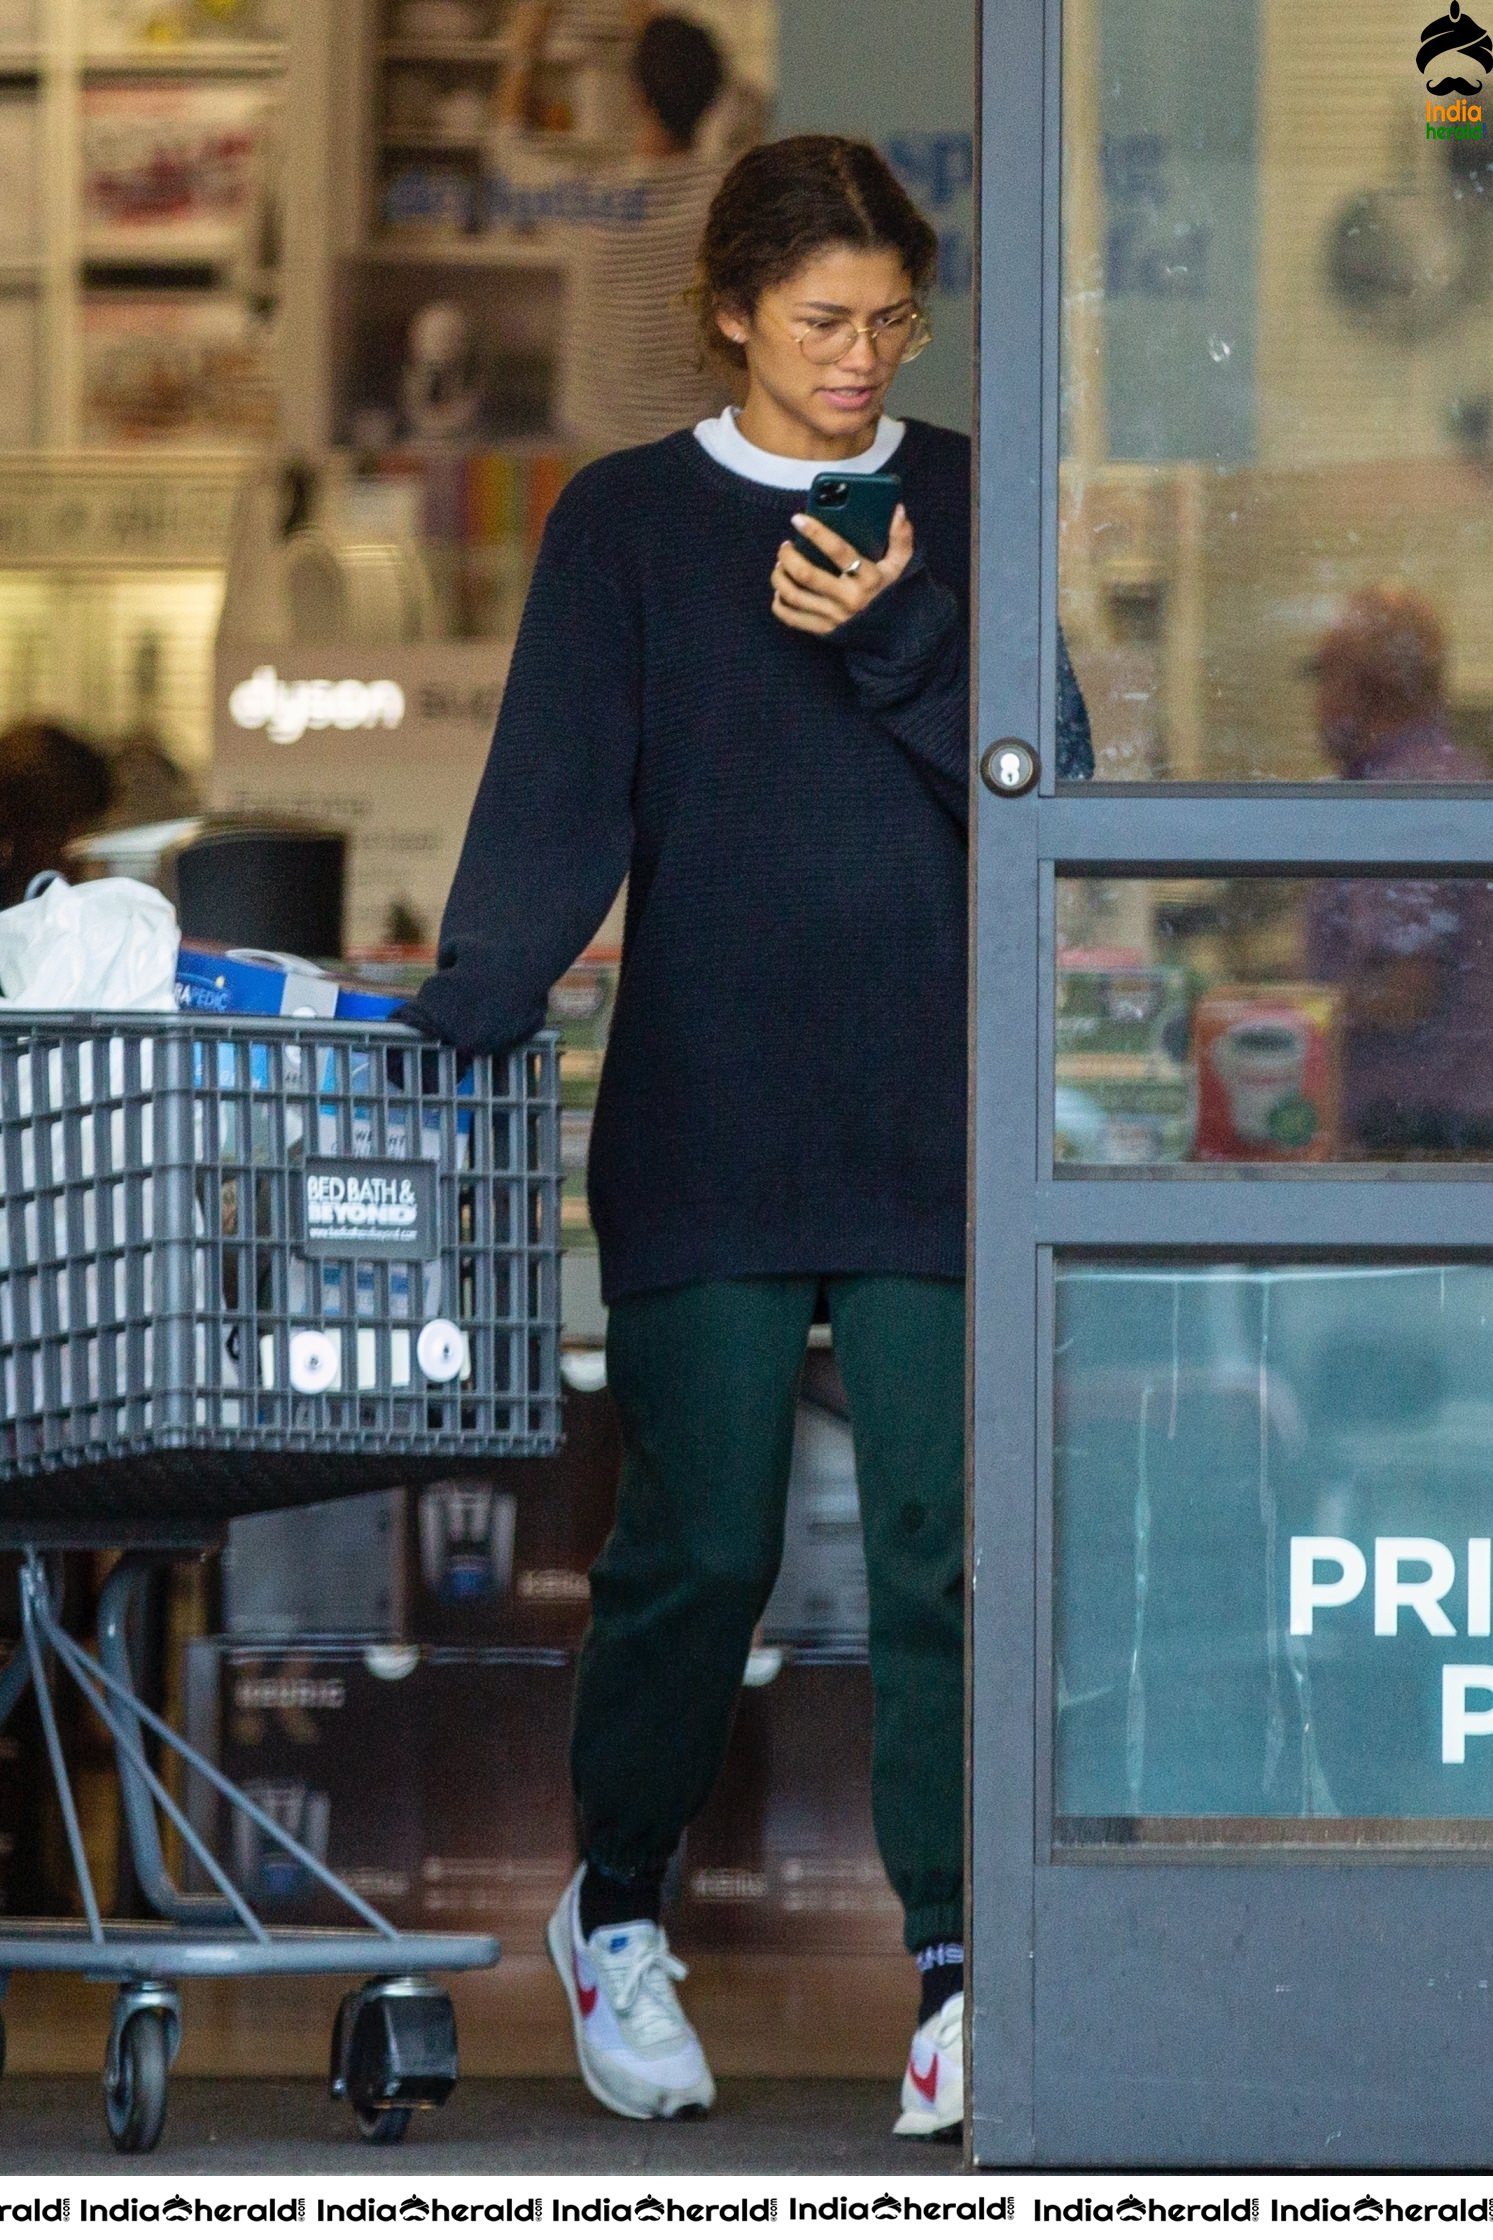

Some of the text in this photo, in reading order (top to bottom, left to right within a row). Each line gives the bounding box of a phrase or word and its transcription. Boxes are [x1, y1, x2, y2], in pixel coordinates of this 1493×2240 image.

[228, 664, 405, 745] dyson
[307, 1175, 416, 1206] BED BATH &
[307, 1200, 418, 1226] BEYOND
[1289, 1535, 1492, 1637] PRI
[1442, 1663, 1493, 1764] P
